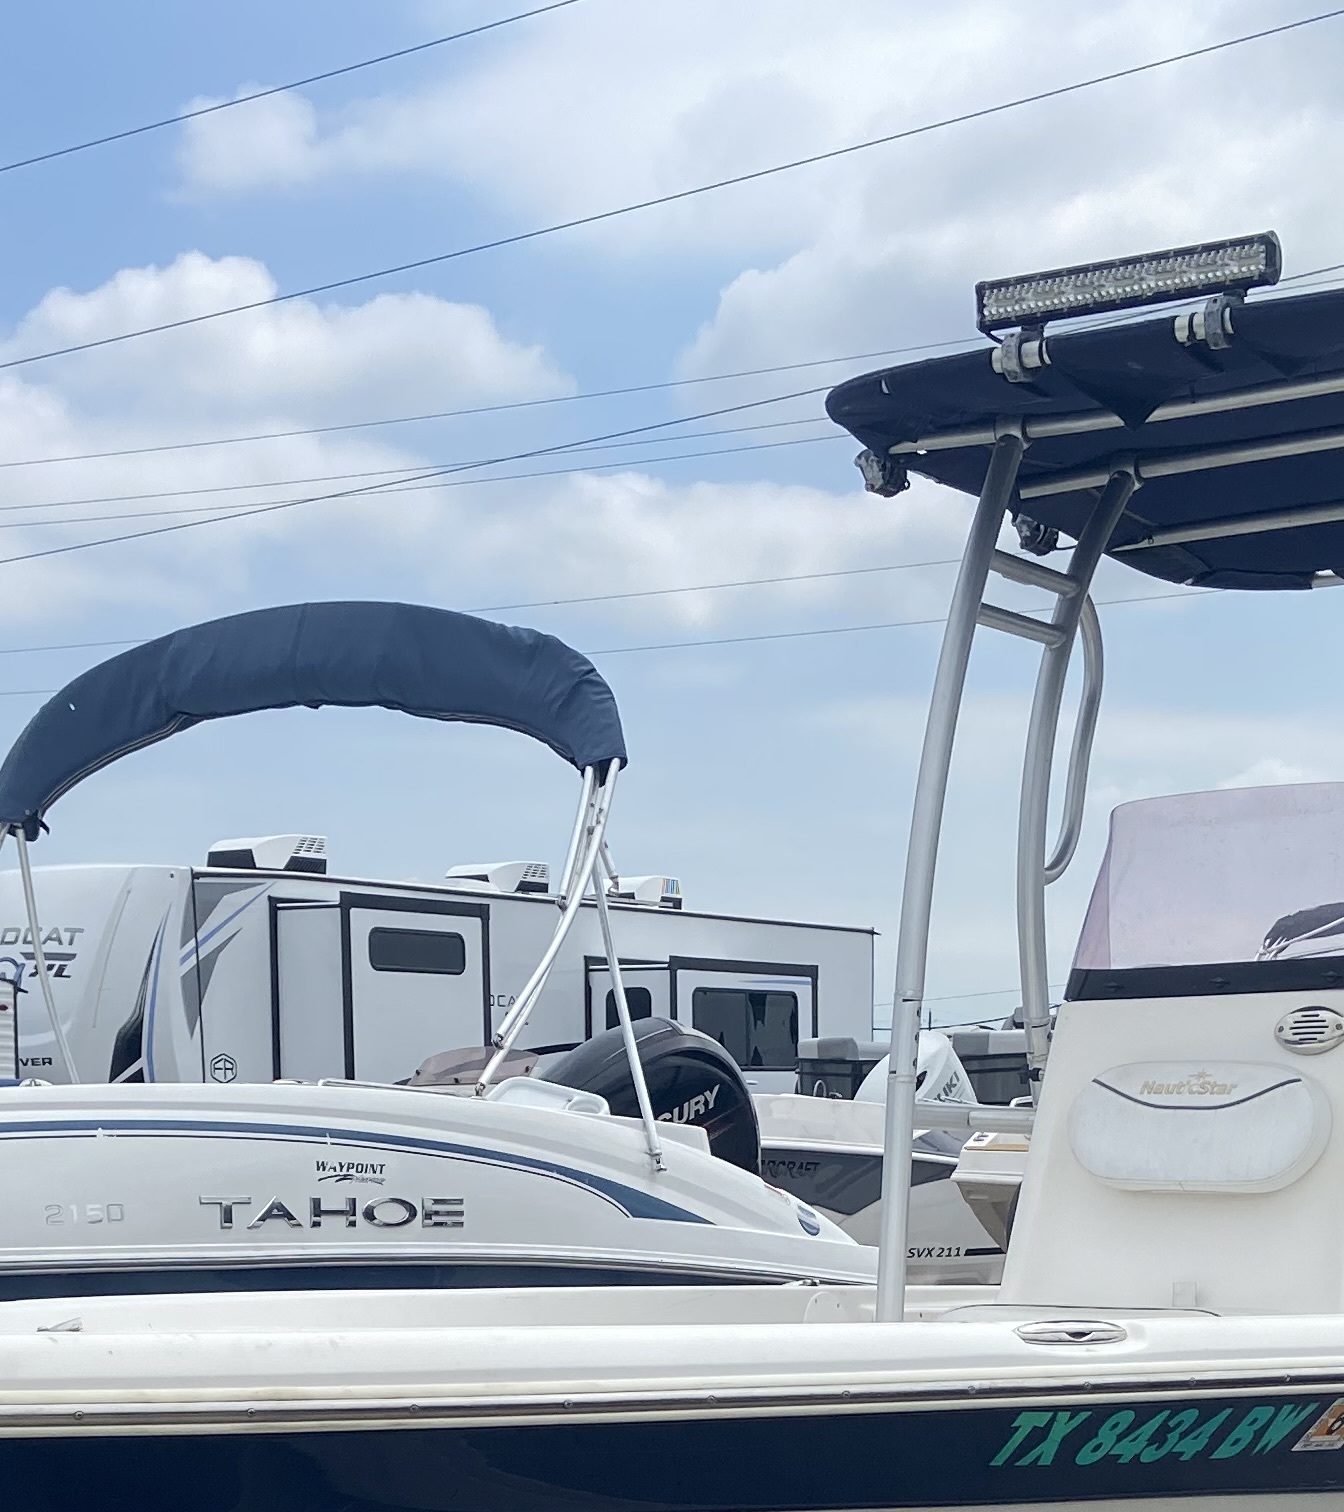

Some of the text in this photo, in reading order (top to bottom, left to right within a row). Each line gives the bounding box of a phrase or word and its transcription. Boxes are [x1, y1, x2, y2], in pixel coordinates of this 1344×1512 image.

[1139, 1080, 1239, 1096] NauticStar
[316, 1160, 386, 1175] WAYPOINT
[45, 1203, 125, 1226] 2150
[199, 1195, 464, 1230] TAHOE
[906, 1246, 962, 1259] SVX 211
[989, 1402, 1320, 1467] TX 8434 BW
